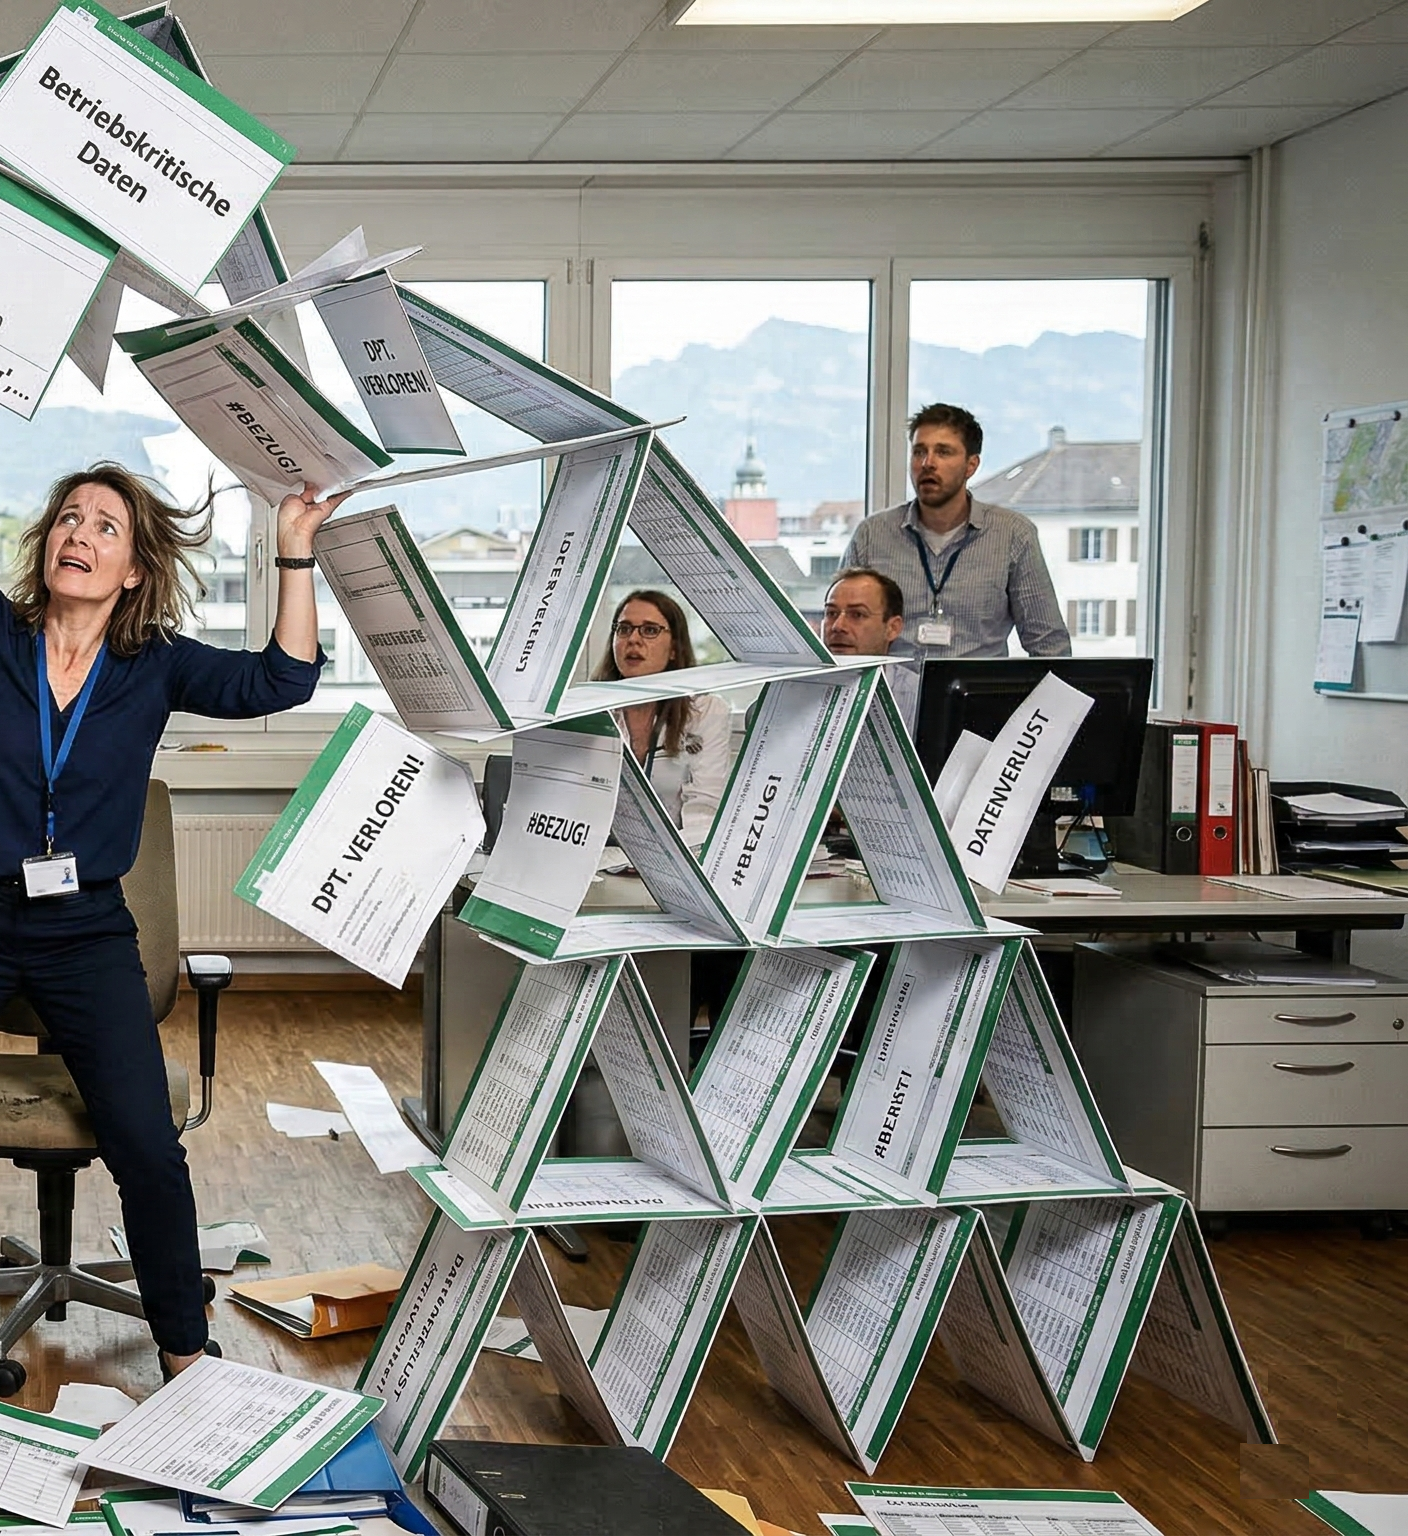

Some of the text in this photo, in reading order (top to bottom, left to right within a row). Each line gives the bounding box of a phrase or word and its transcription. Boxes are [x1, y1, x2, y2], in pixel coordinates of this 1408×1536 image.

[38, 65, 231, 217] Betriebskritische
[76, 140, 148, 204] Daten
[358, 369, 432, 396] VERLOREN!
[362, 339, 396, 362] DPT.
[226, 402, 303, 474] #BEZUG!
[966, 708, 1050, 857] DATENVERLUST
[311, 867, 352, 915] DPT.
[342, 754, 426, 863] VERLOREN!
